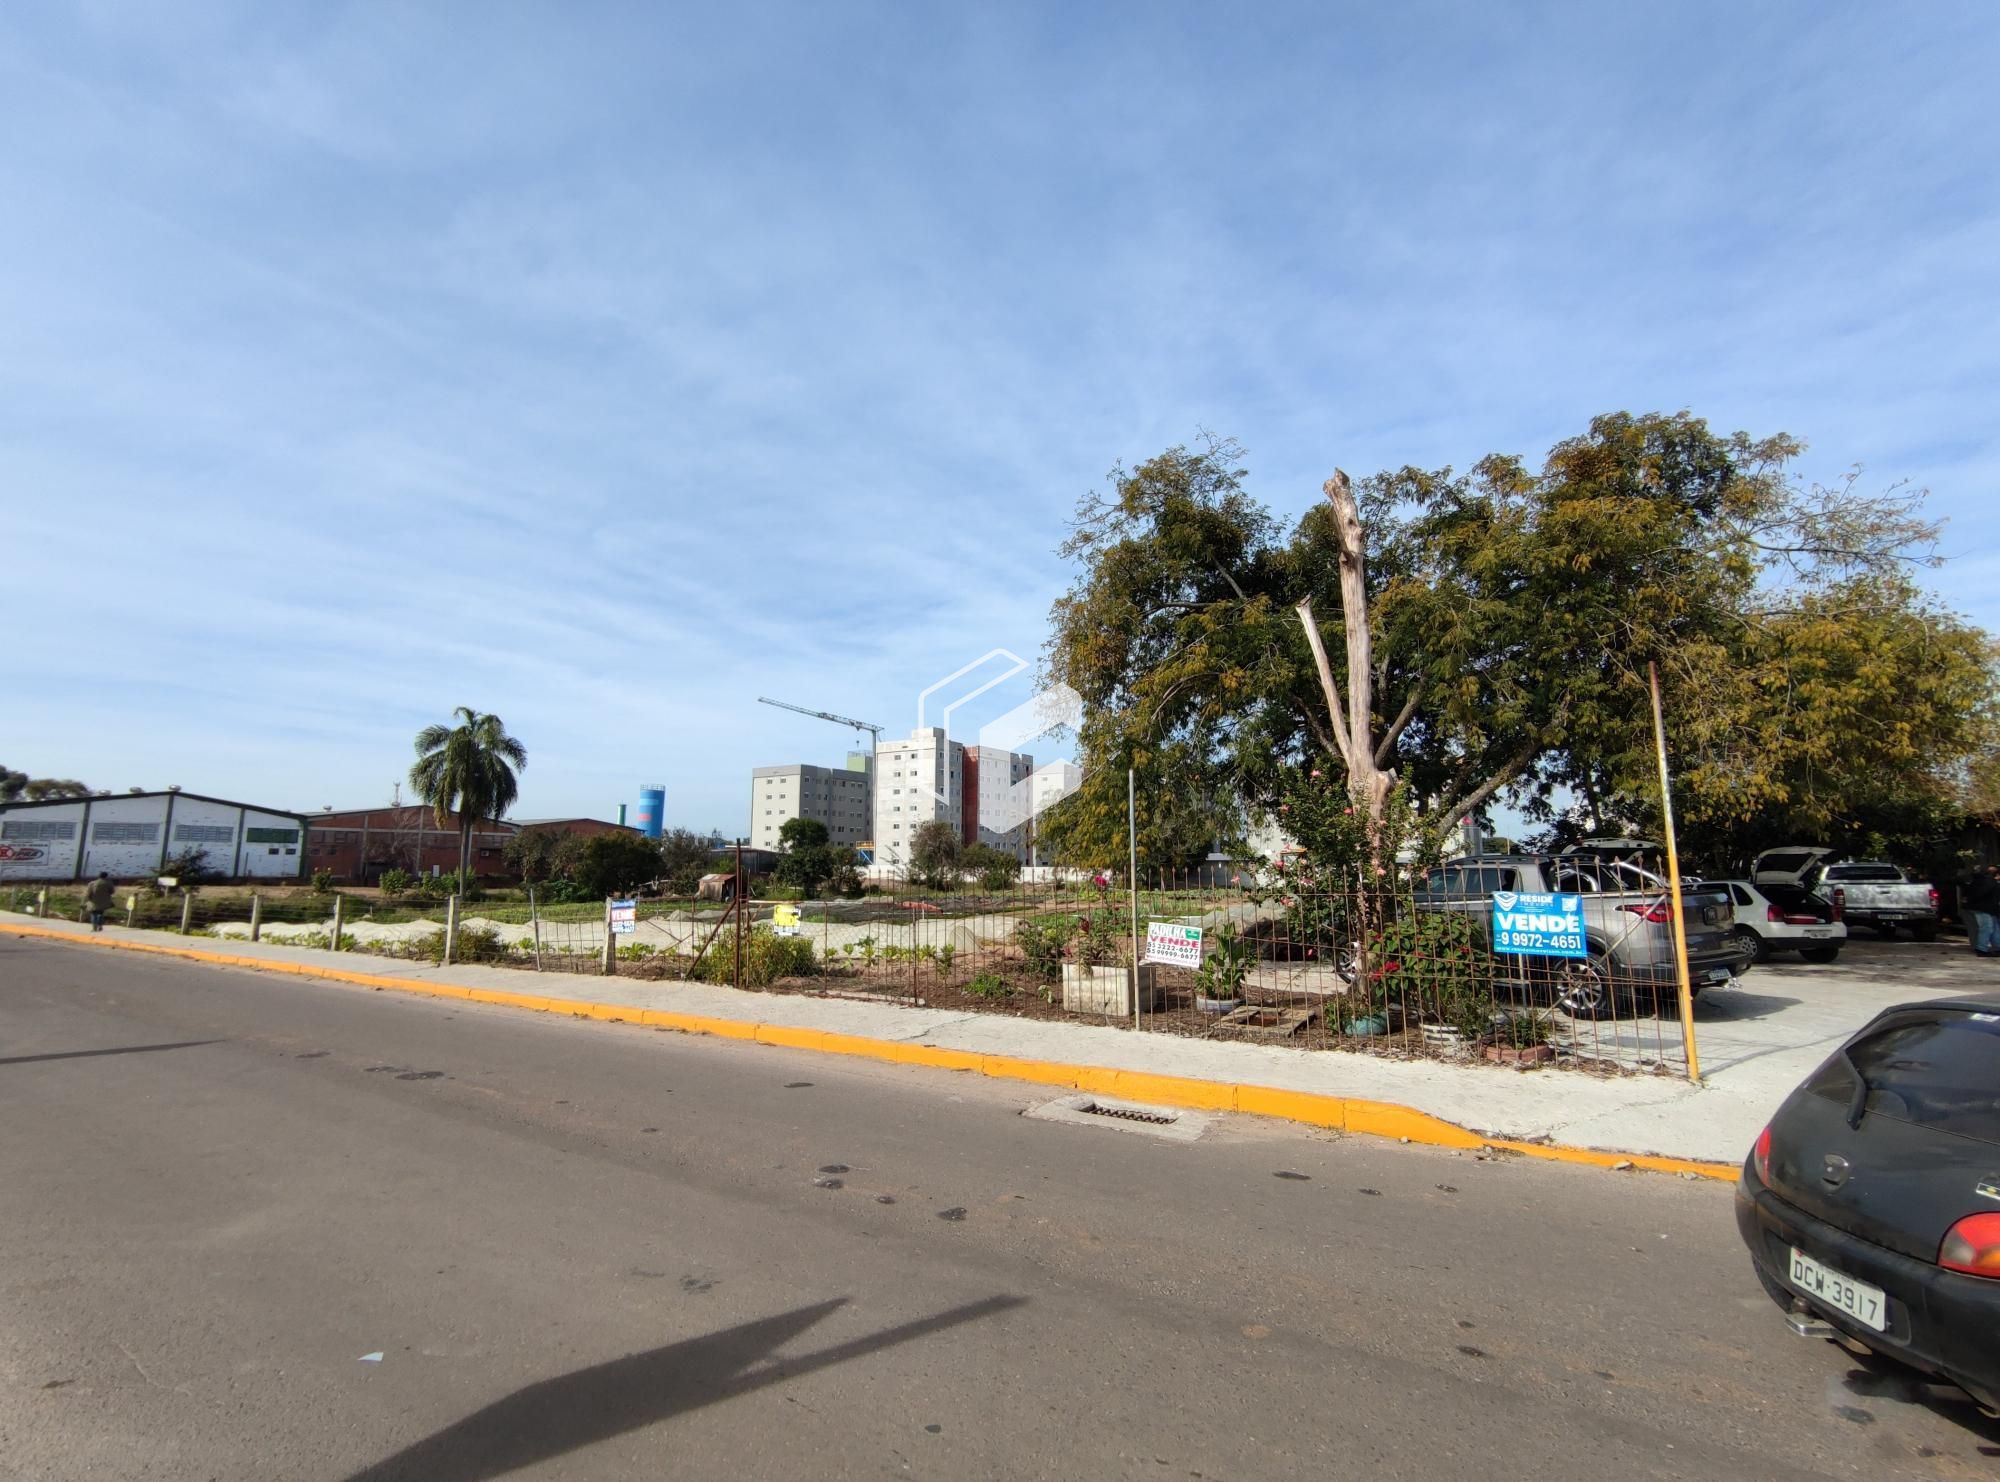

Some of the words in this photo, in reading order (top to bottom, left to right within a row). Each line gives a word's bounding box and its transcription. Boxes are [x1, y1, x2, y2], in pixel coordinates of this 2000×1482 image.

[1520, 895, 1553, 903] RESIDE
[1496, 912, 1580, 933] VENDE
[1150, 935, 1200, 949] VENDE
[1511, 932, 1582, 949] 9972-4651
